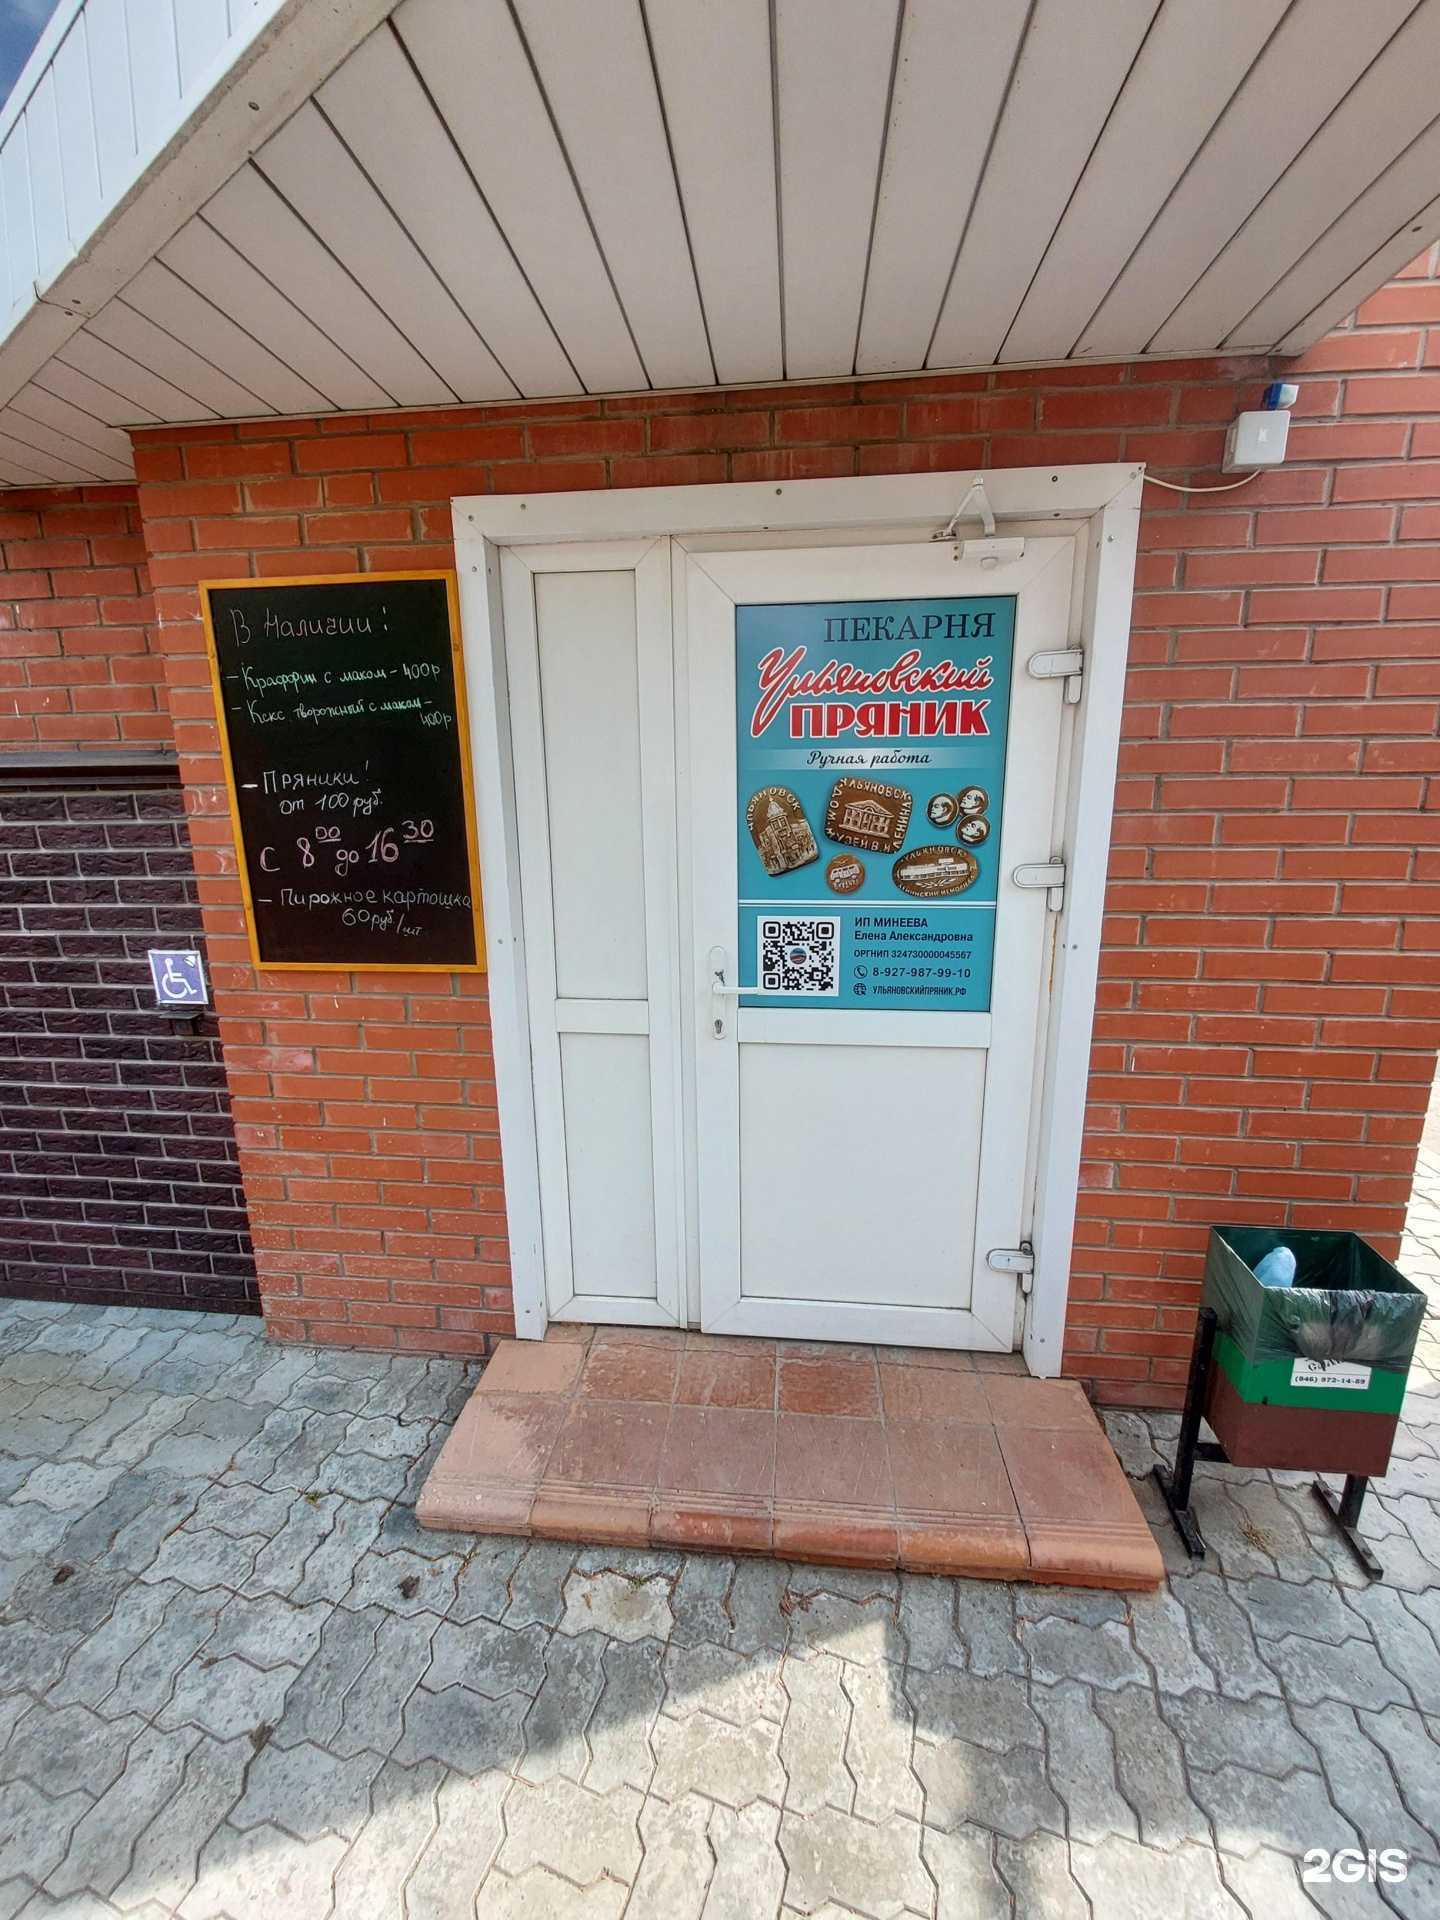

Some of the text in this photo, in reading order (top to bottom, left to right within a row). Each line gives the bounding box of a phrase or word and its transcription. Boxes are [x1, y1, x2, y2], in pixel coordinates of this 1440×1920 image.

[230, 608, 251, 647] В
[824, 612, 996, 642] ПЕКАРНЯ
[340, 669, 387, 682] маком
[751, 645, 994, 738] Ульяновский
[247, 700, 285, 726] Кекс
[293, 699, 364, 726] творожный
[789, 699, 991, 739] ПРЯНИК
[806, 750, 933, 768] Ручная работа
[279, 798, 304, 815] от
[314, 792, 349, 811] 100
[334, 849, 359, 876] до
[280, 888, 378, 910] Пирожное
[383, 889, 472, 911] картошка
[855, 917, 929, 928] ИП МИНЕЕВА
[854, 930, 974, 944] Елена Александровна
[854, 949, 889, 958] ОРГНИП
[872, 967, 971, 978] 8-927-987-99-10
[873, 985, 967, 996] УЛЬЯНОВСКИЙПРЯНИК.РФ
